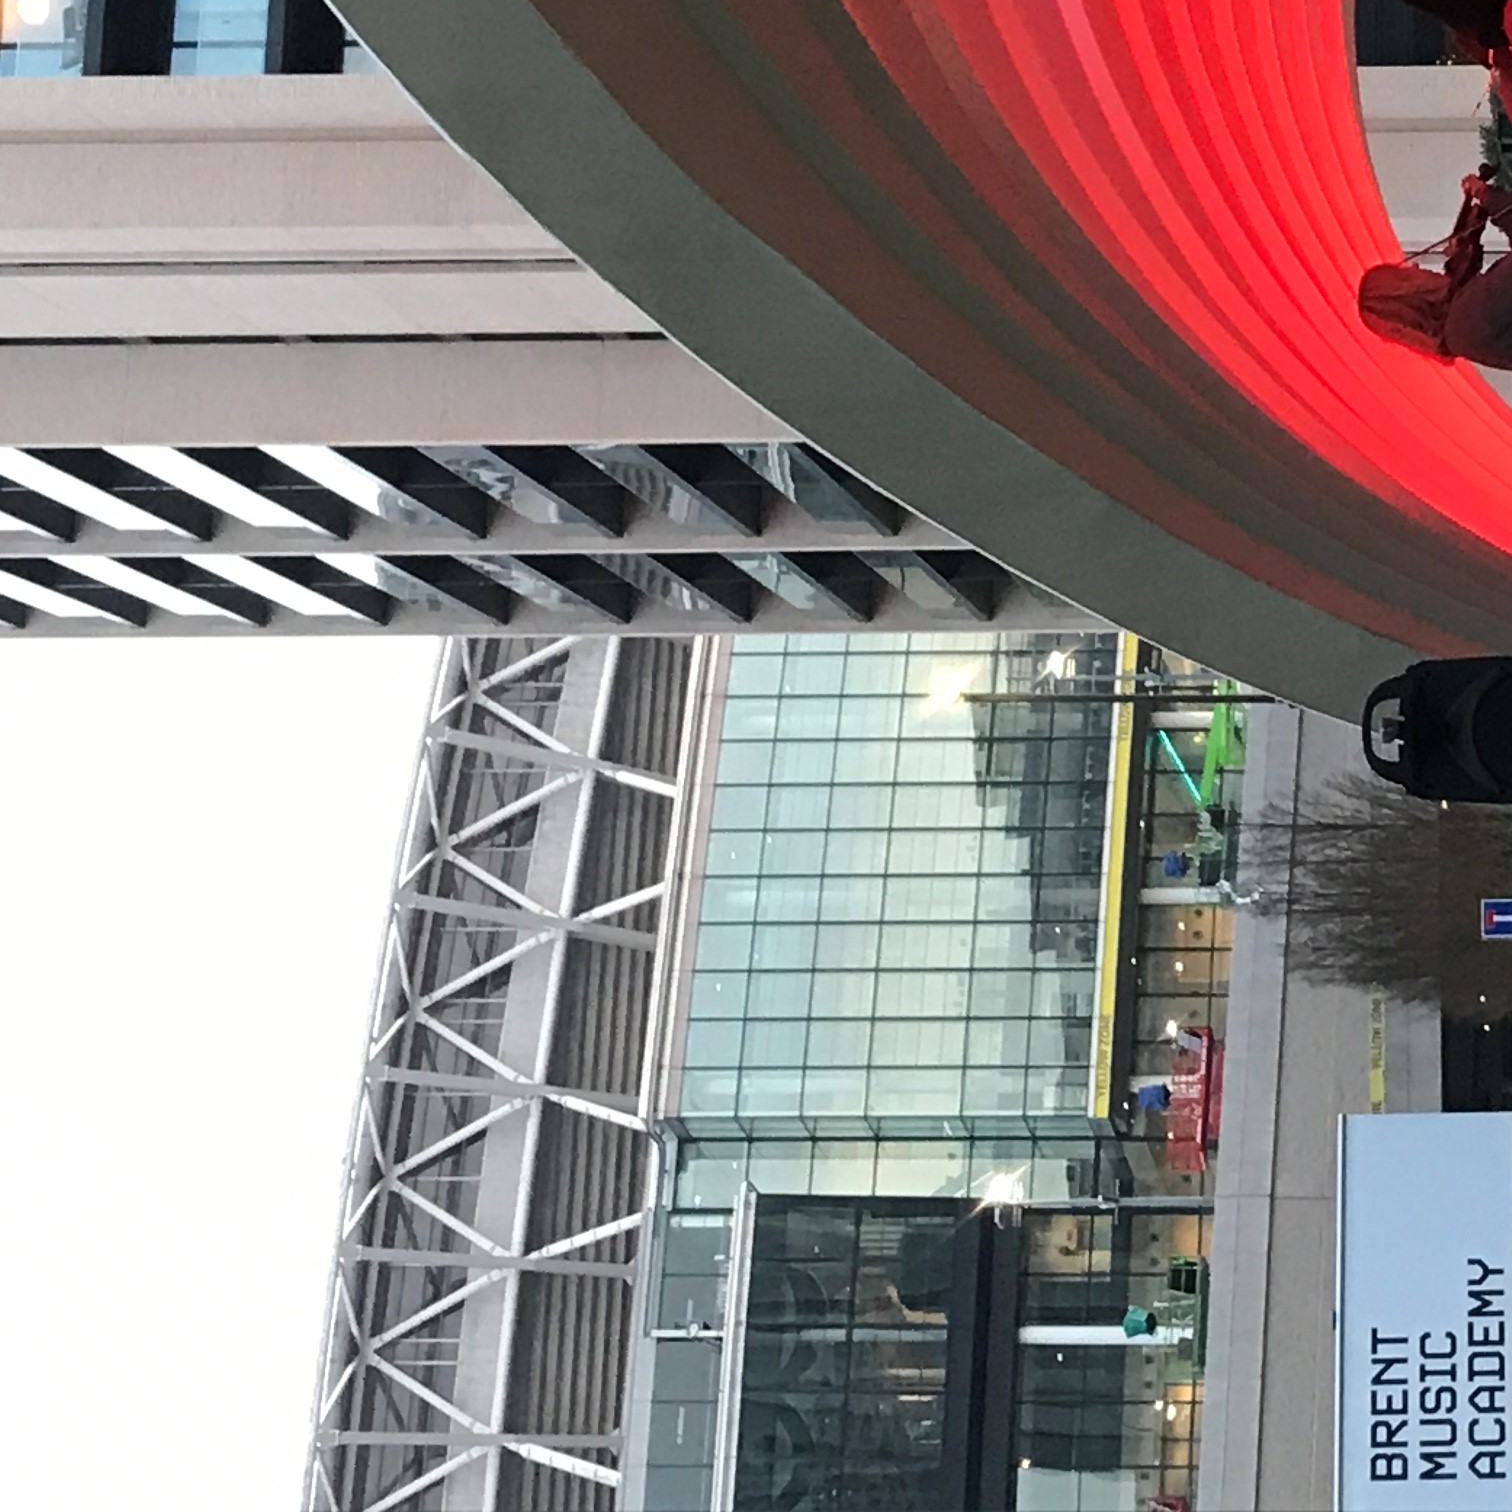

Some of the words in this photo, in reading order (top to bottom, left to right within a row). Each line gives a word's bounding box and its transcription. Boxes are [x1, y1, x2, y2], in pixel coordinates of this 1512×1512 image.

[1370, 1327, 1409, 1482] BRENT
[1419, 1331, 1458, 1480] MUSIC
[1467, 1258, 1506, 1480] ACADEMY
